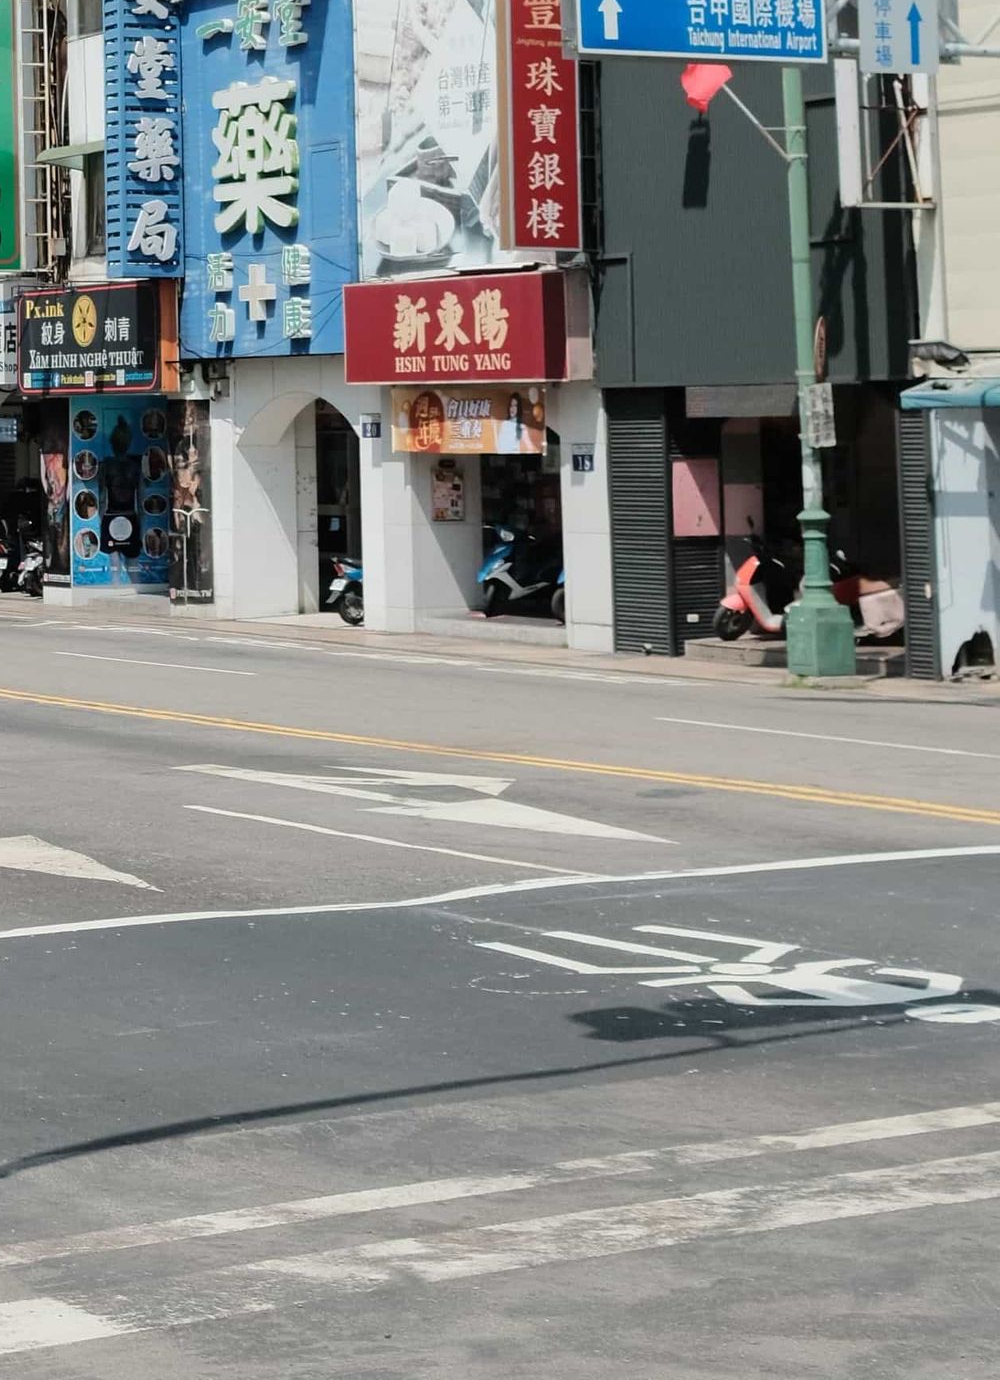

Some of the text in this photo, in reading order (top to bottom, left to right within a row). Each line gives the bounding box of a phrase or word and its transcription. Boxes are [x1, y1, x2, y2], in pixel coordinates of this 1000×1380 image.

[687, 26, 817, 53] Taichung International Airport
[438, 62, 492, 91] 台灣特產
[211, 76, 299, 235] 藥
[207, 252, 236, 343] 活力
[281, 243, 312, 340] 健康
[25, 300, 64, 320] Px.ink
[392, 287, 511, 353] 新東陽
[41, 320, 66, 346] 紋身
[104, 316, 131, 343] 刺青
[395, 352, 512, 374] HSIN TUNG YANG
